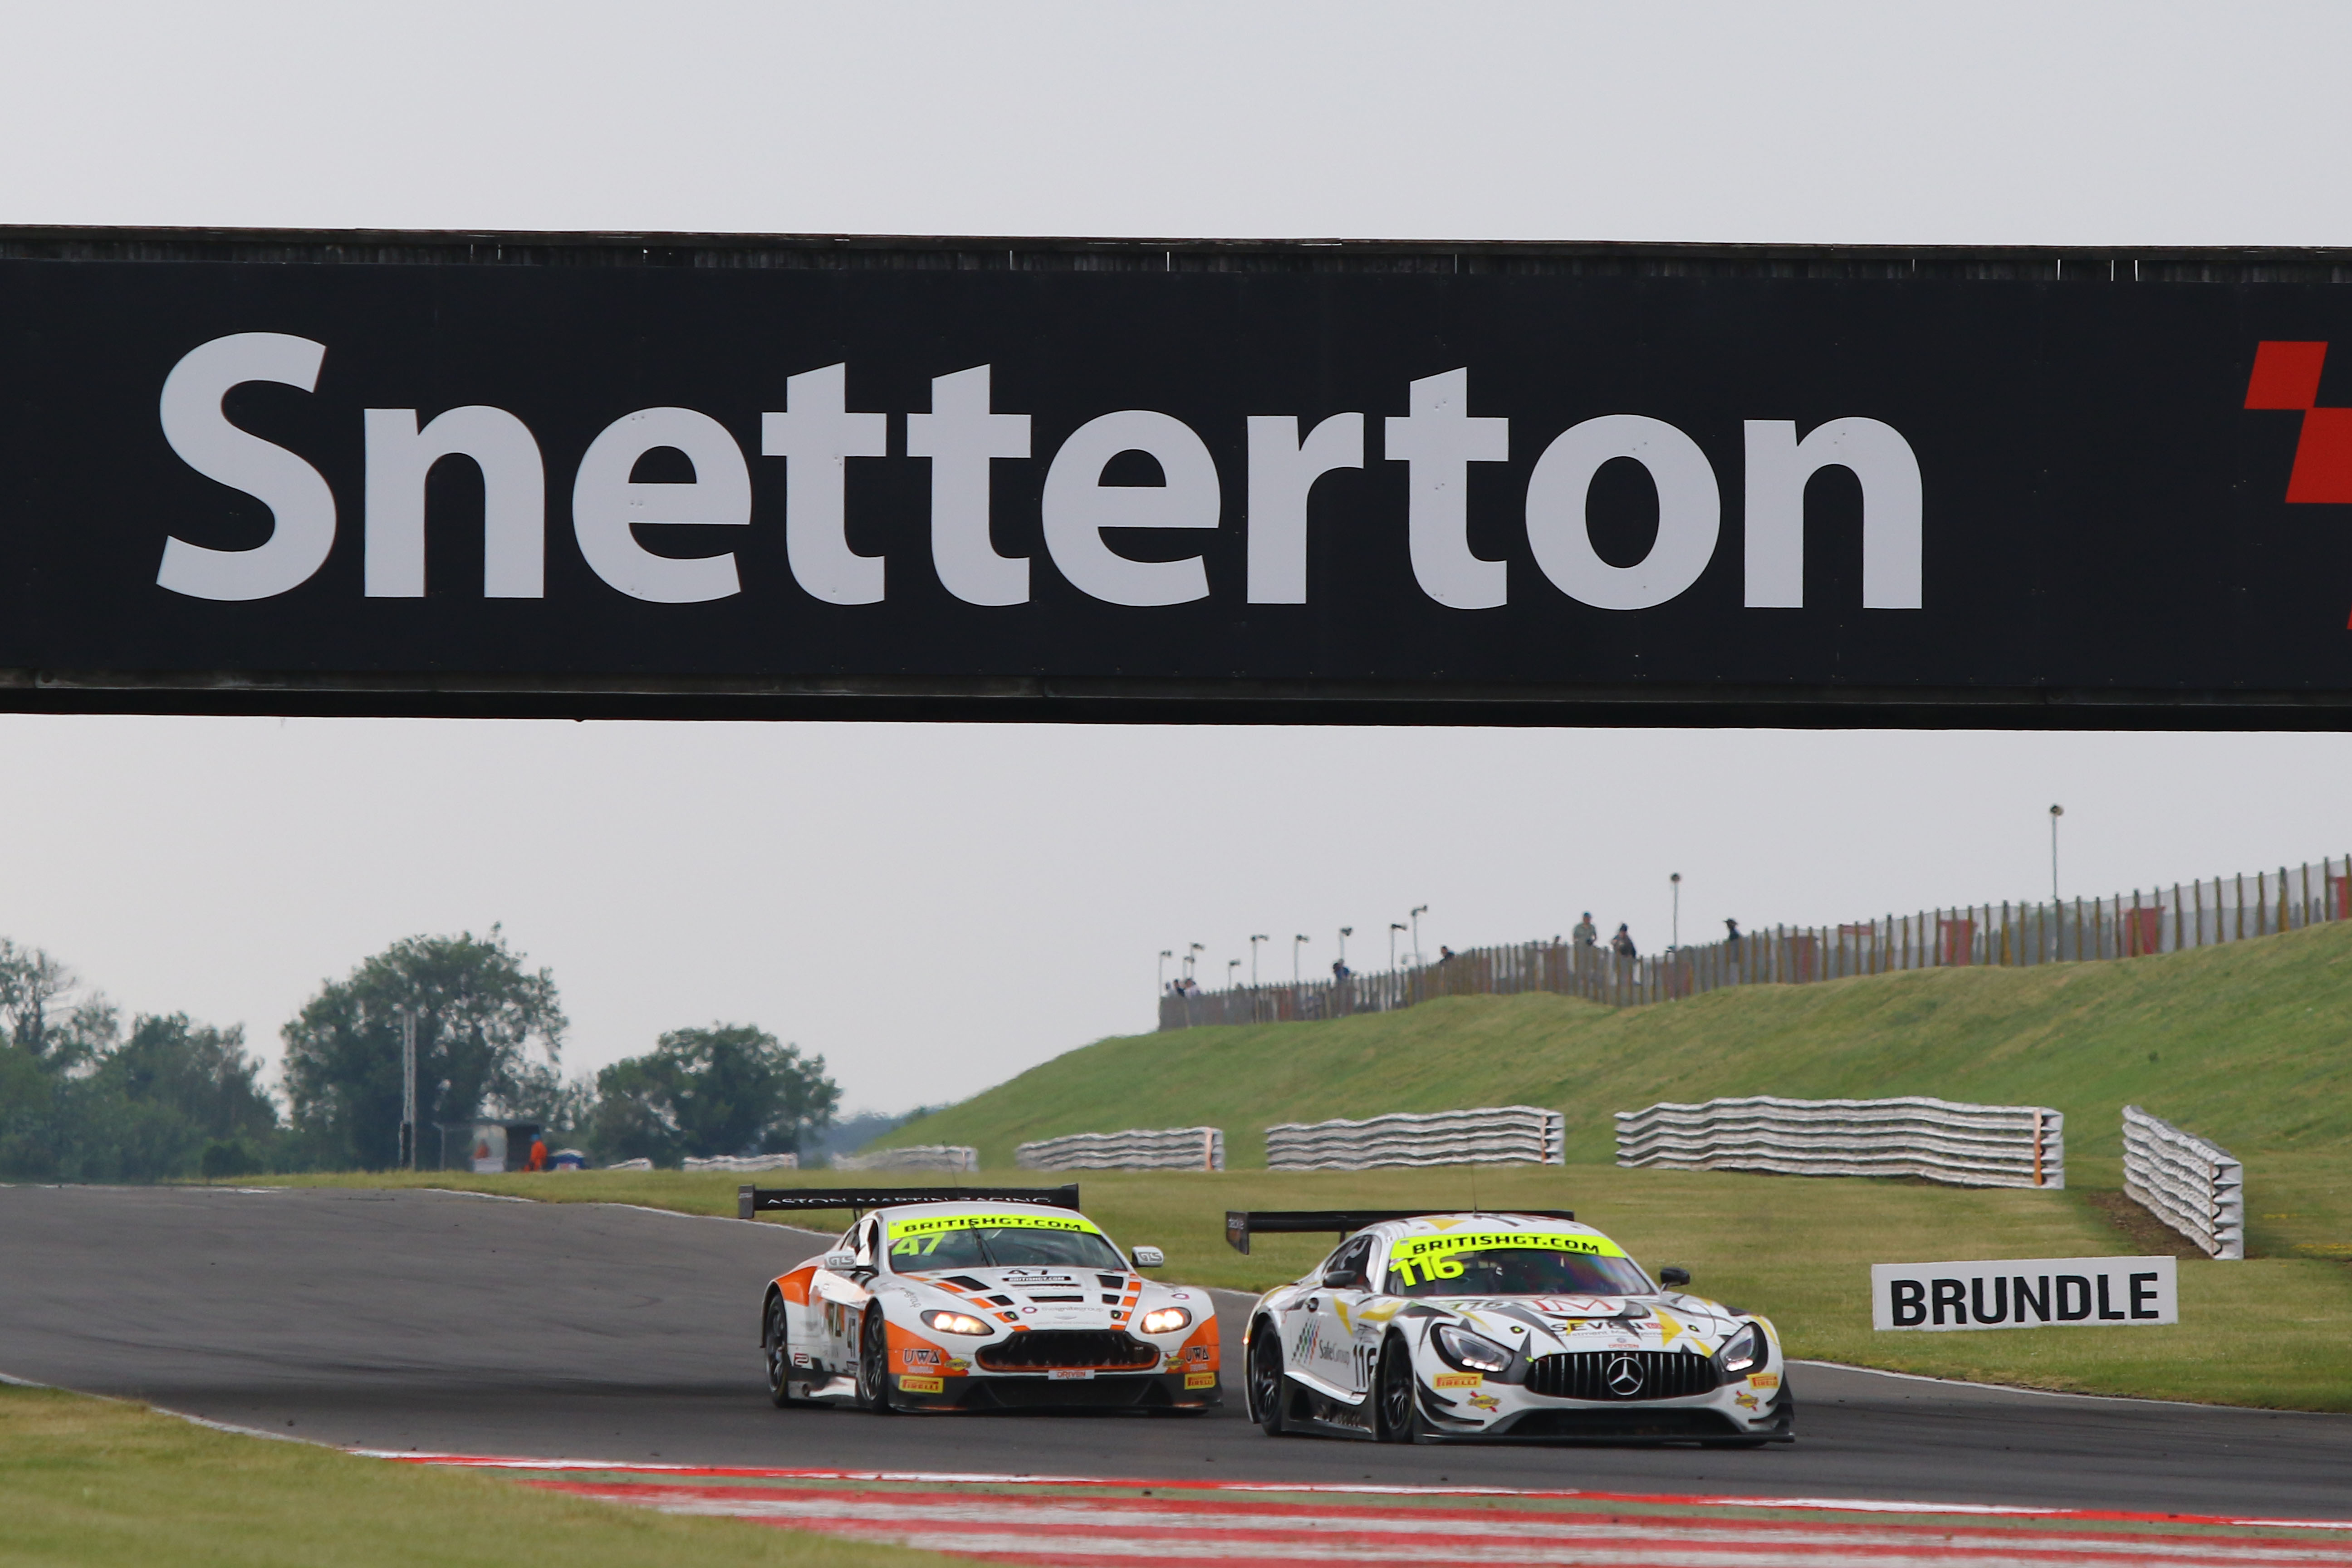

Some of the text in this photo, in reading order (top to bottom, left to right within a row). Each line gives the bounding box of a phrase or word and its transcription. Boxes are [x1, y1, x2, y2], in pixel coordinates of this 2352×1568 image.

[157, 333, 1922, 610] Snetterton
[904, 1217, 1081, 1233] BRITISHGT.COM
[891, 1231, 946, 1256] 47
[1412, 1235, 1599, 1255] BRITISHGT.COM
[1389, 1253, 1465, 1287] 116
[1891, 1272, 2159, 1327] BRUNDLE
[1550, 1321, 1645, 1332] SEVEN
[902, 1379, 940, 1391] PIRELLI
[1437, 1376, 1478, 1387] PIRELLI
